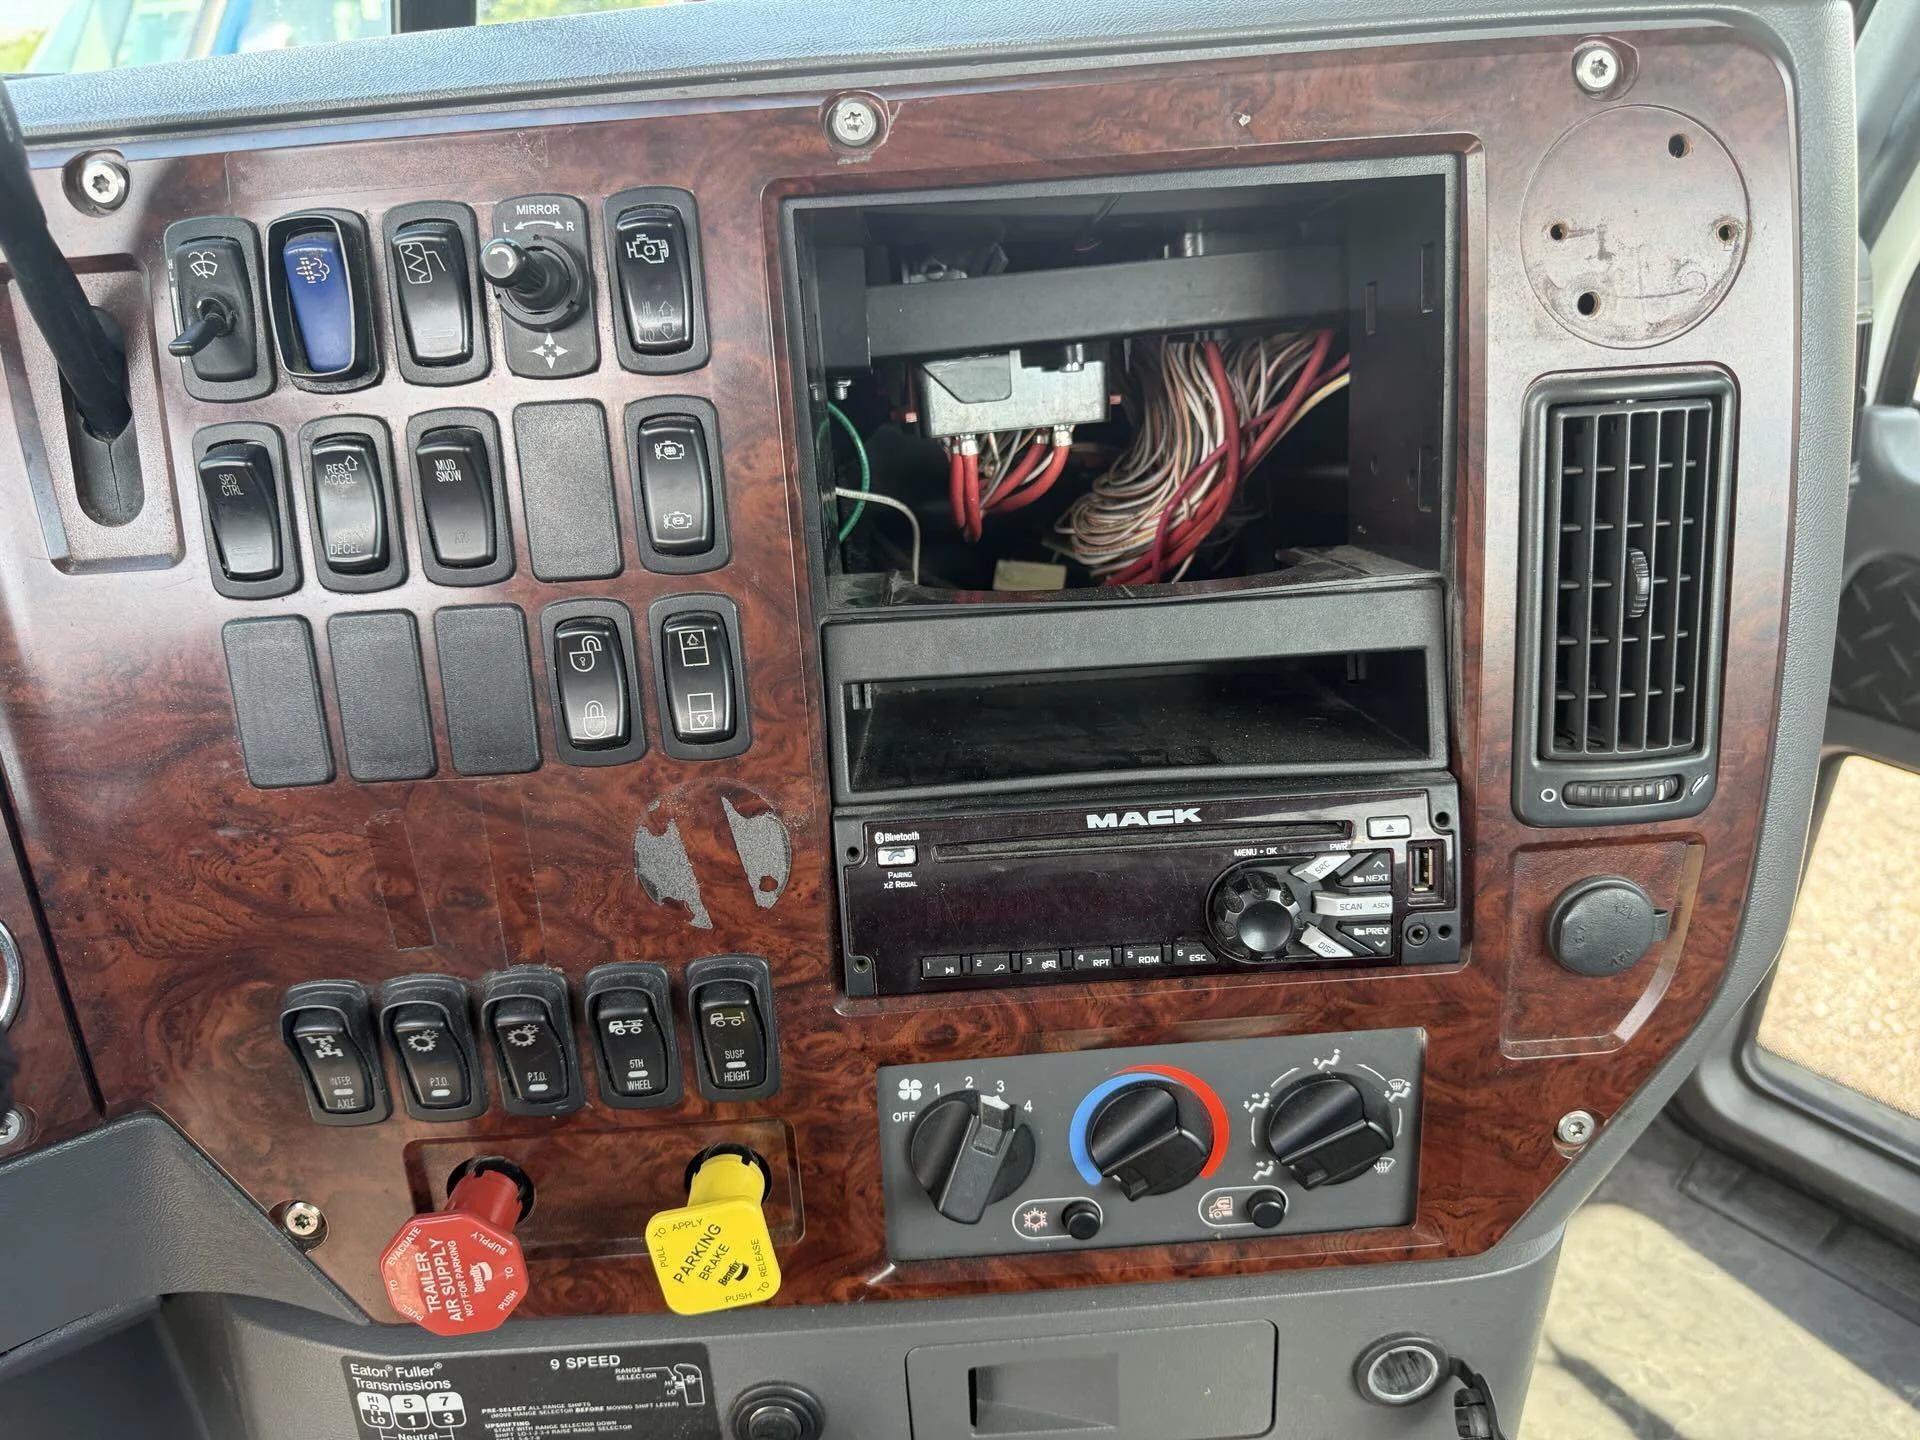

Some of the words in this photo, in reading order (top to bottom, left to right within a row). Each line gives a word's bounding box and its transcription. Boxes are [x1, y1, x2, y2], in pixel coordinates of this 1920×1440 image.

[515, 203, 561, 216] MIRROR
[502, 222, 510, 233] L
[566, 221, 575, 232] R
[434, 458, 457, 471] MUD
[218, 473, 237, 486] SPD
[324, 473, 357, 486] ACCEL
[436, 469, 462, 482] SNOW
[221, 484, 245, 497] CTRL
[330, 543, 361, 555] DECEL
[1085, 807, 1202, 829] MACK
[884, 831, 920, 842] Bluetooth
[1233, 849, 1258, 857] MENU
[1266, 846, 1278, 855] OK
[1329, 842, 1349, 851] PWR
[1314, 860, 1331, 875] SRC
[1365, 873, 1389, 882] NEXT
[1338, 902, 1363, 911] SCAN
[1365, 927, 1389, 935] PREV
[1317, 940, 1337, 955] DISP
[1026, 957, 1033, 965] 3
[1077, 954, 1084, 962] 4
[1092, 958, 1110, 968] RPT
[1127, 951, 1134, 959] 5
[1177, 949, 1184, 957] 6
[1189, 953, 1207, 962] ESC
[976, 959, 983, 967] 2
[724, 1049, 745, 1060] SUSP
[628, 1058, 645, 1069] 5TH
[526, 1071, 547, 1082] P.T.O.
[723, 1070, 751, 1083] HEIGHT
[964, 1075, 974, 1089] 2
[627, 1079, 652, 1090] WHEEL
[934, 1082, 941, 1096] 1
[996, 1079, 1005, 1093] 3
[337, 1098, 355, 1110] AXLE
[1023, 1099, 1033, 1113] 4
[892, 1111, 917, 1123] OFF
[671, 1217, 704, 1232] APPLY
[653, 1226, 667, 1239] TO
[387, 1226, 422, 1266] EVACUATE
[470, 1230, 508, 1256] SUPPLY
[447, 1239, 465, 1280] PARKING
[655, 1245, 669, 1269] PULL
[672, 1223, 722, 1285] PARKING
[750, 1237, 769, 1279] RELEASE
[428, 1237, 457, 1298] SUPPLY
[698, 1242, 731, 1281] BRAKE
[469, 1263, 486, 1294] Bendix
[504, 1266, 514, 1280] TO
[717, 1258, 742, 1287] Bendix
[389, 1279, 399, 1291] TO
[414, 1251, 442, 1314] TRAILER
[757, 1280, 770, 1294] TO
[457, 1280, 470, 1299] FOR
[497, 1289, 519, 1311] PUSH
[724, 1291, 753, 1304] PUSH
[402, 1304, 424, 1322] PULL
[445, 1298, 465, 1322] AIR
[462, 1298, 475, 1317] NOT
[549, 1358, 561, 1371] 9
[565, 1354, 621, 1370] SPEED
[614, 1367, 642, 1375] RANGE
[616, 1372, 658, 1381] SELECTOR
[352, 1376, 452, 1392] Transmissions
[366, 1395, 380, 1405] HI
[403, 1398, 414, 1409] 5
[439, 1396, 449, 1407] 7
[481, 1406, 527, 1414] PRE-SELECT
[542, 1402, 566, 1410] RANGE
[513, 1409, 537, 1417] RANGE
[538, 1407, 575, 1416] SELECTOR
[575, 1405, 605, 1414] BEFORE
[634, 1402, 654, 1410] SHIFT
[407, 1414, 417, 1427] 1
[443, 1412, 455, 1424] 3
[484, 1420, 531, 1429] UPSHIFTING
[535, 1423, 559, 1431] RANGE
[559, 1421, 595, 1430] SELECTOR
[573, 1426, 596, 1434] RANGE
[597, 1424, 633, 1432] SELECTOR
[397, 1431, 439, 1440] Neutral
